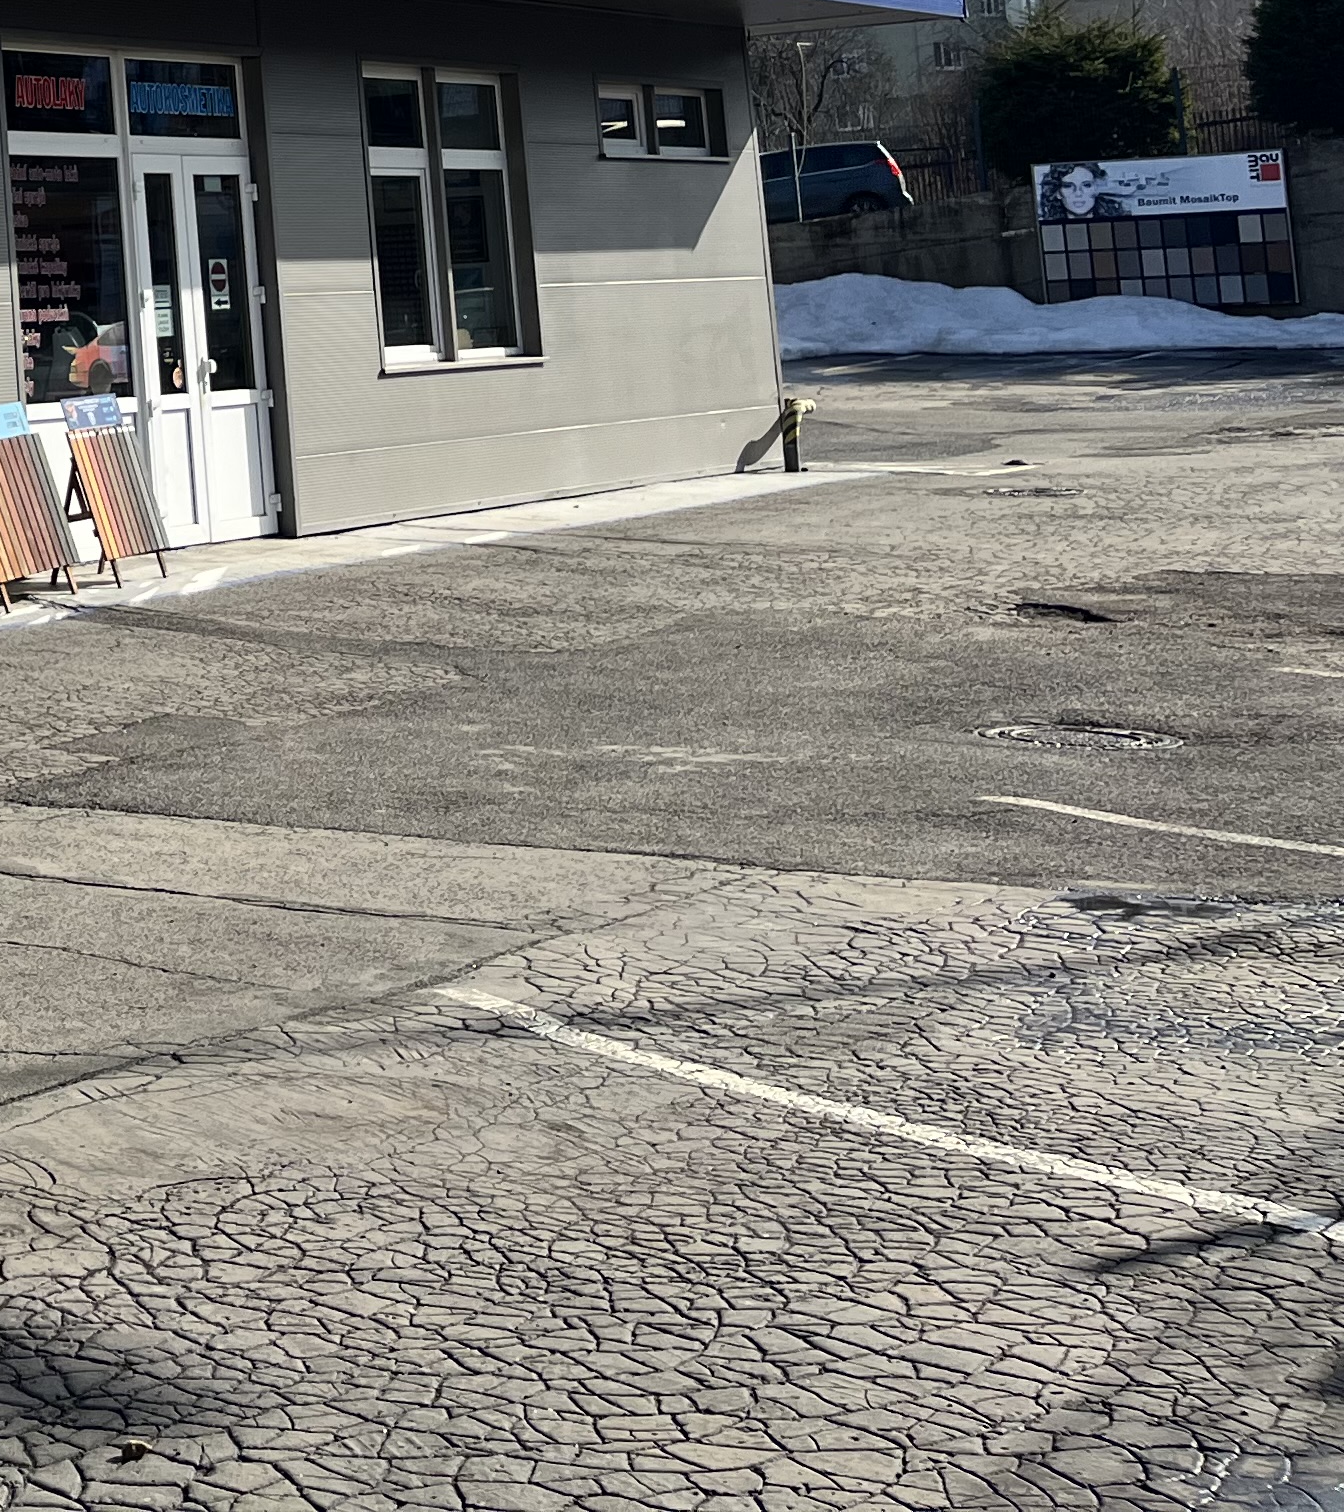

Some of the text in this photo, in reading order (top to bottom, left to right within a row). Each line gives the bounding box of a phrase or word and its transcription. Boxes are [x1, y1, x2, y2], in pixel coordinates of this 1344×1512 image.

[15, 75, 85, 111] AUTOLAKY
[130, 81, 235, 117] AUTOKOSMETIKA
[1137, 193, 1240, 207] Baumit MosaikTop
